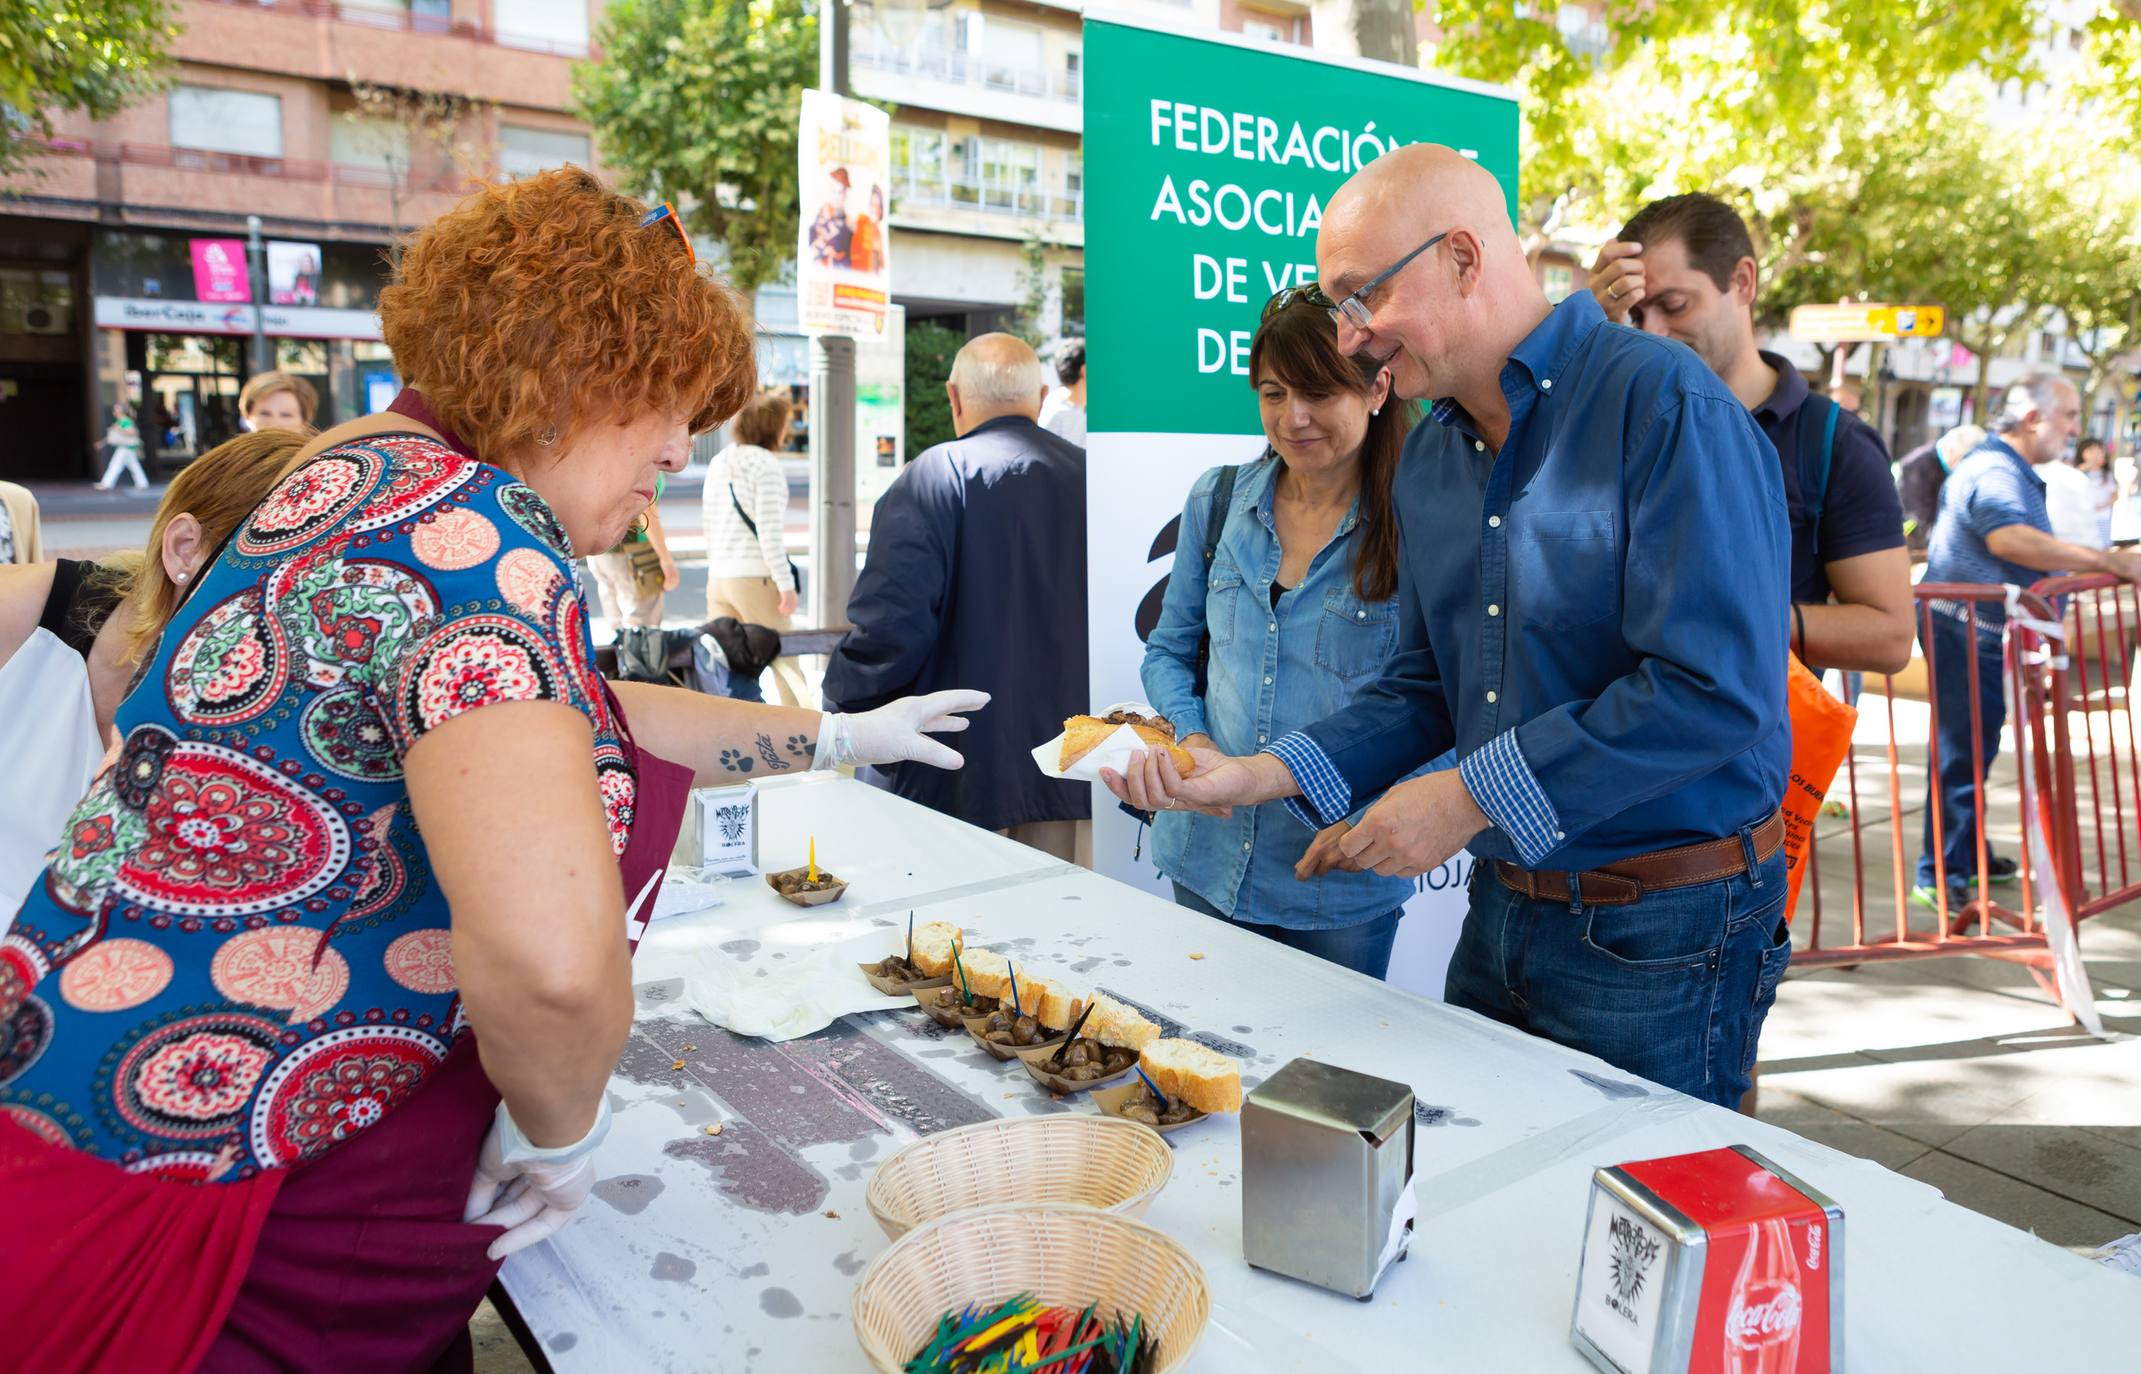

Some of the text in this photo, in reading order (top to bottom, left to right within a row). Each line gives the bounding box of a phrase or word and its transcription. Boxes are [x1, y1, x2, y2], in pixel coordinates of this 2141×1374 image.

[1151, 98, 1420, 174] FEDERACIÓ
[1193, 253, 1248, 303] DE
[1197, 328, 1251, 375] DE
[1605, 1293, 1639, 1327] BOLERA
